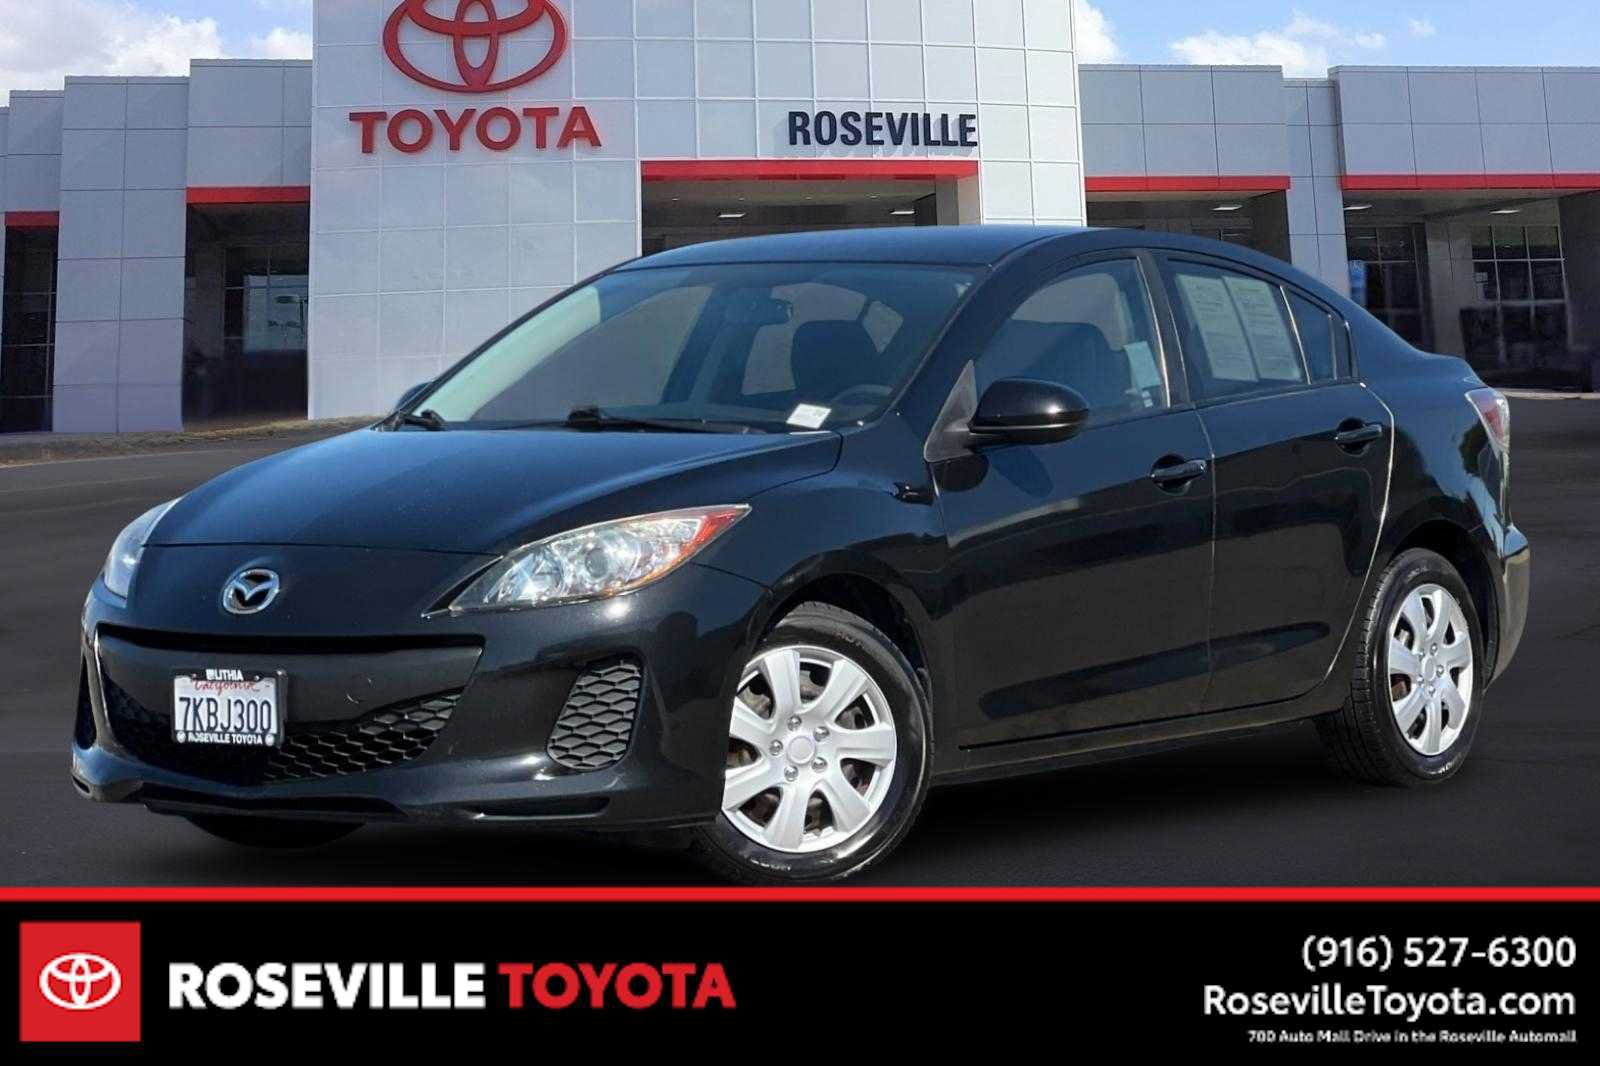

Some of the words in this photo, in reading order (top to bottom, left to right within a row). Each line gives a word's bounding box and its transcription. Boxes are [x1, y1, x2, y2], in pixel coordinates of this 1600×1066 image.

[349, 106, 602, 154] TOYOTA
[788, 110, 979, 147] ROSEVILLE
[215, 669, 244, 681] LITHIA
[179, 696, 272, 733] 7KBJ300
[231, 733, 263, 745] TOYOTA
